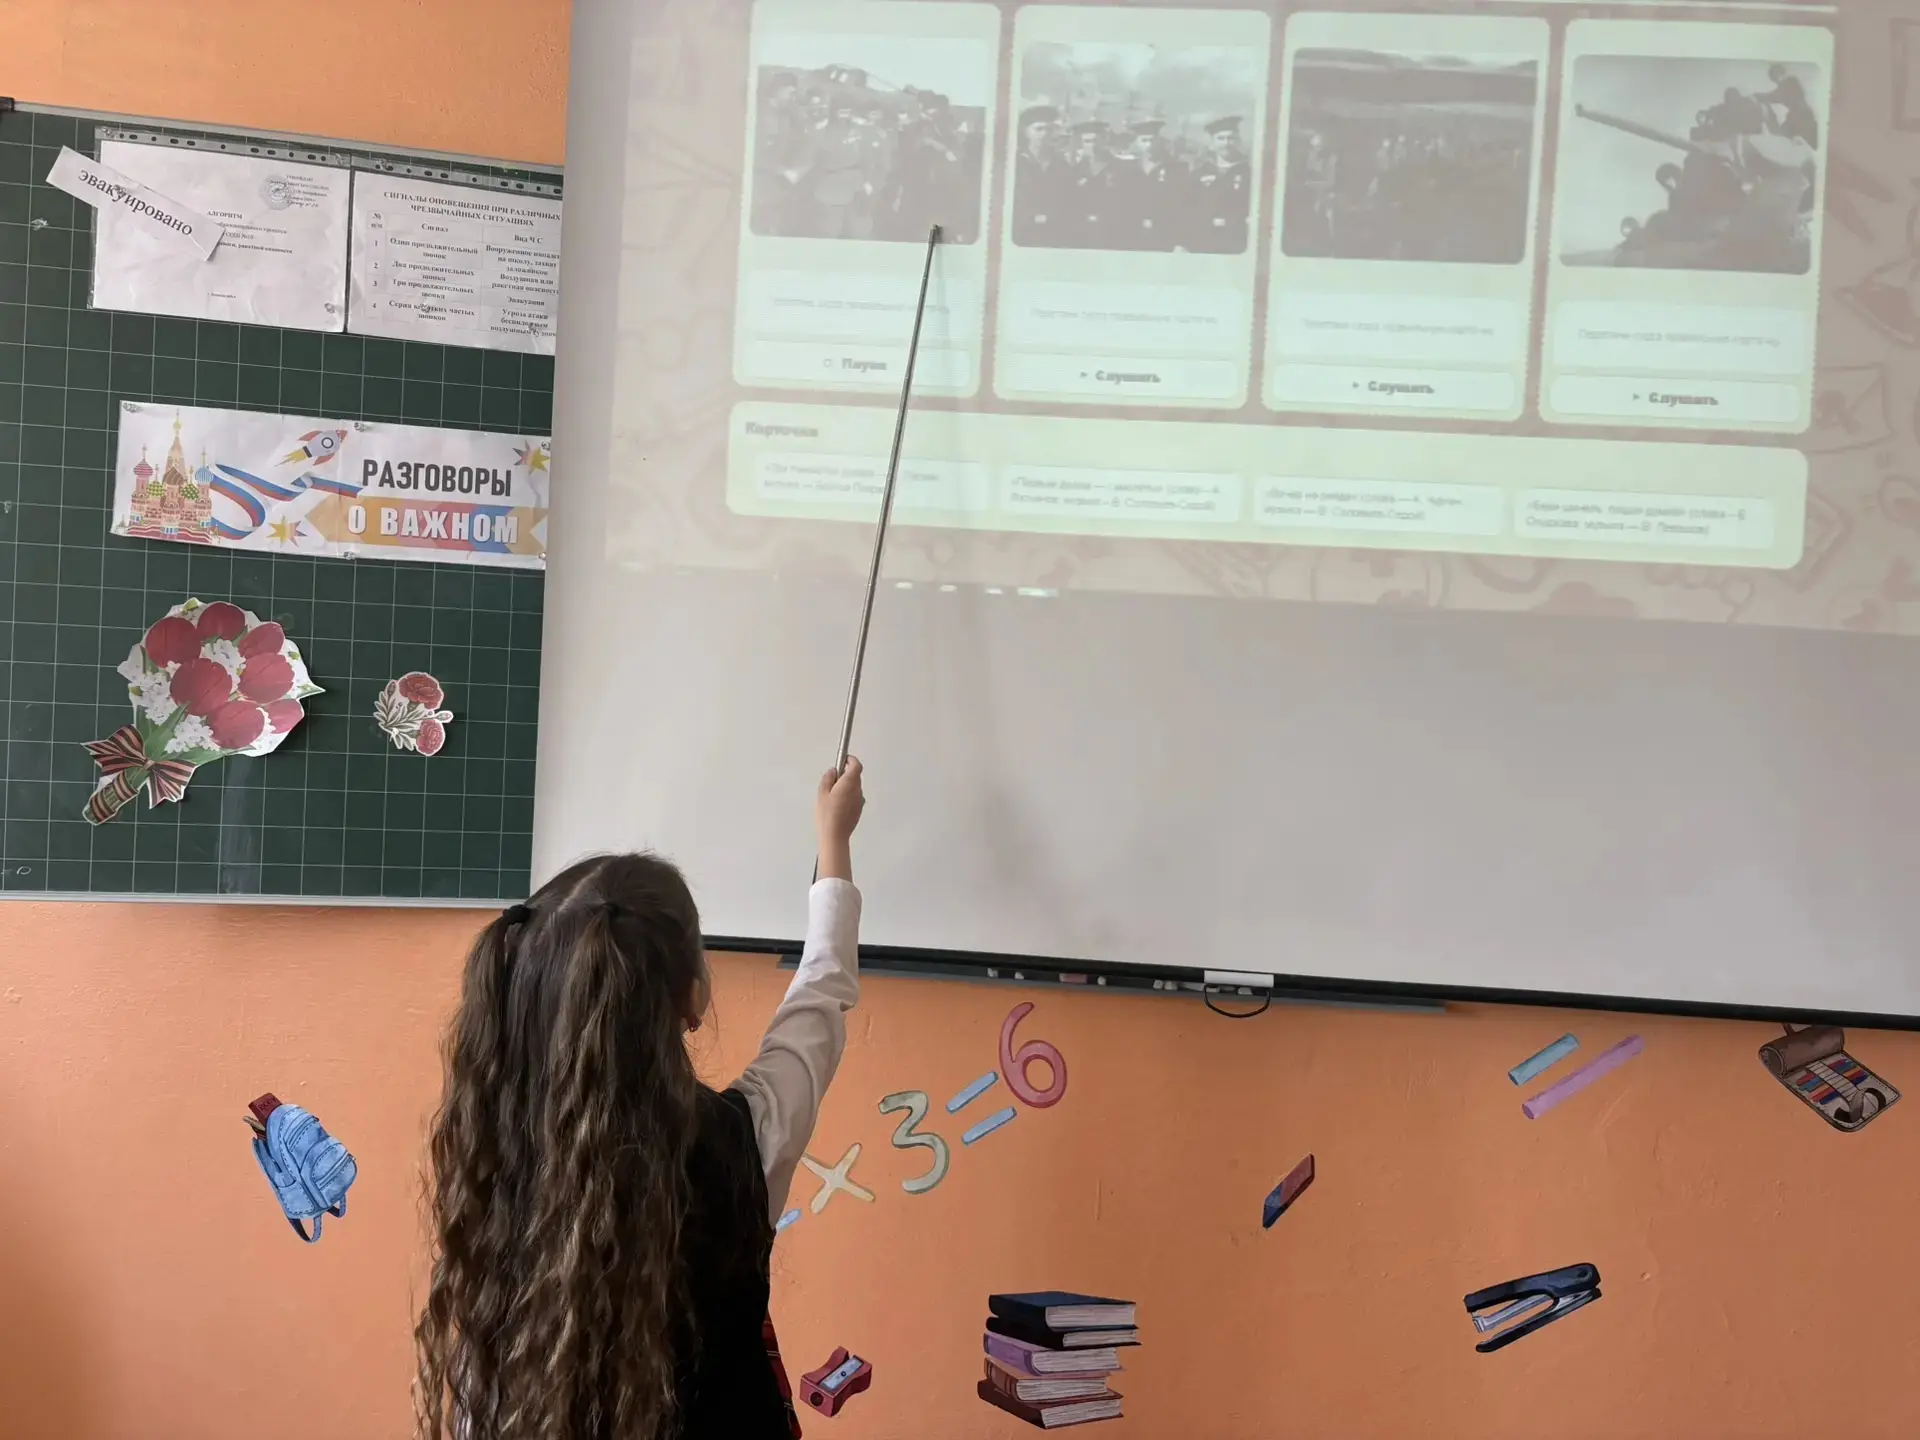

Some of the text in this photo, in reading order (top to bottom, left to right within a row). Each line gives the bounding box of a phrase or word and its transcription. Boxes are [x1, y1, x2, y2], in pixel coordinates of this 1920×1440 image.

[78, 169, 193, 236] эвакуировано
[383, 191, 561, 221] СИГНАЛЫ ОПОВЕЩЕНИЯ ПРИ РАЗЛИЧНЫХ
[207, 210, 243, 219] АЛГОРИТМ
[410, 204, 534, 227] ЧРЕЗВЫЧАЙНЫХ СИТУАЦИЯХ
[421, 222, 449, 232] Сигнал
[390, 237, 478, 255] Один продолжительный
[408, 264, 475, 276] продолжительных
[408, 281, 474, 294] продолжительных
[388, 299, 412, 309] Серия
[449, 308, 475, 316] частых
[502, 308, 527, 318] Угроза
[362, 458, 512, 497] РАЗГОВОРЫ
[348, 505, 519, 545] О ВАЖНОМ
